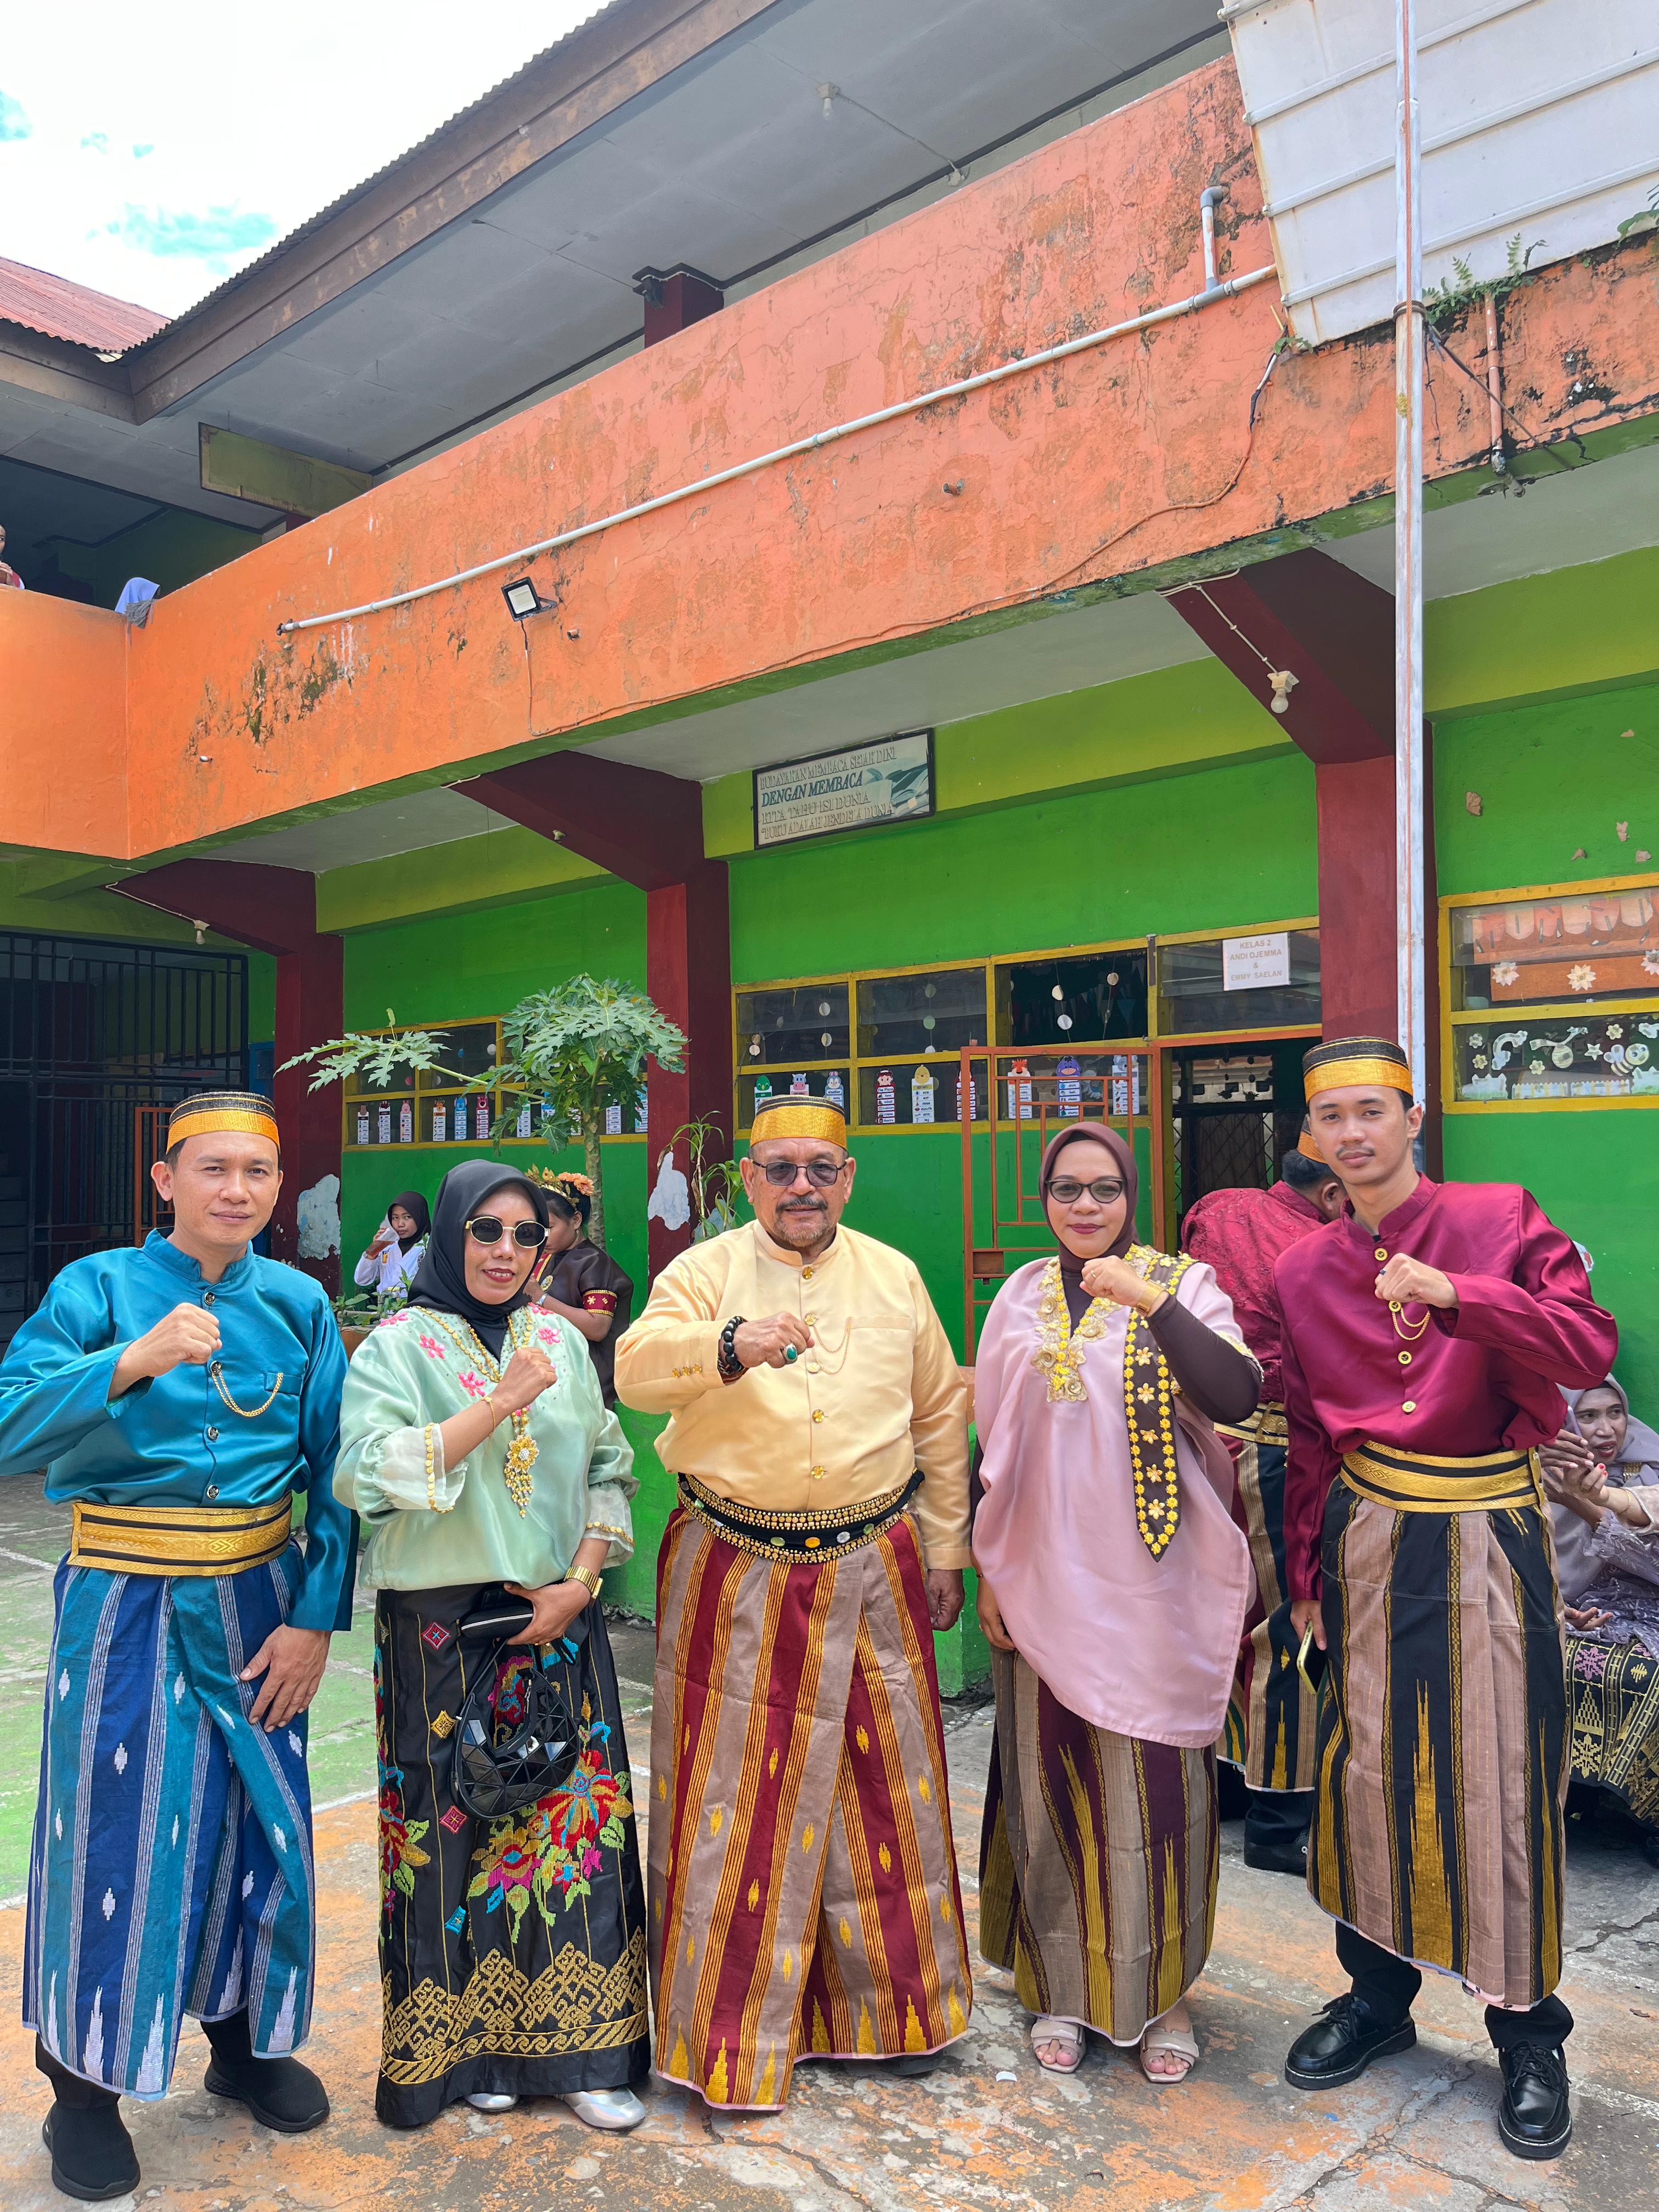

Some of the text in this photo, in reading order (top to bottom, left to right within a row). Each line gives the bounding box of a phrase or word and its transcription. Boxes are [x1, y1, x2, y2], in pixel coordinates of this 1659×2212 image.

[760, 746, 896, 790] BUDAYAKAN MEMBACA SEJAK DINI
[761, 770, 863, 808] DENGAN MEMBACA
[762, 791, 871, 825] KITA TAHU ISI DUNIA
[788, 817, 823, 834] ADALAH
[823, 808, 865, 827] JENDELA
[1229, 949, 1282, 961] ANDI DJEMMA
[1240, 940, 1265, 949] KELAS
[1254, 970, 1282, 979] SAELAN
